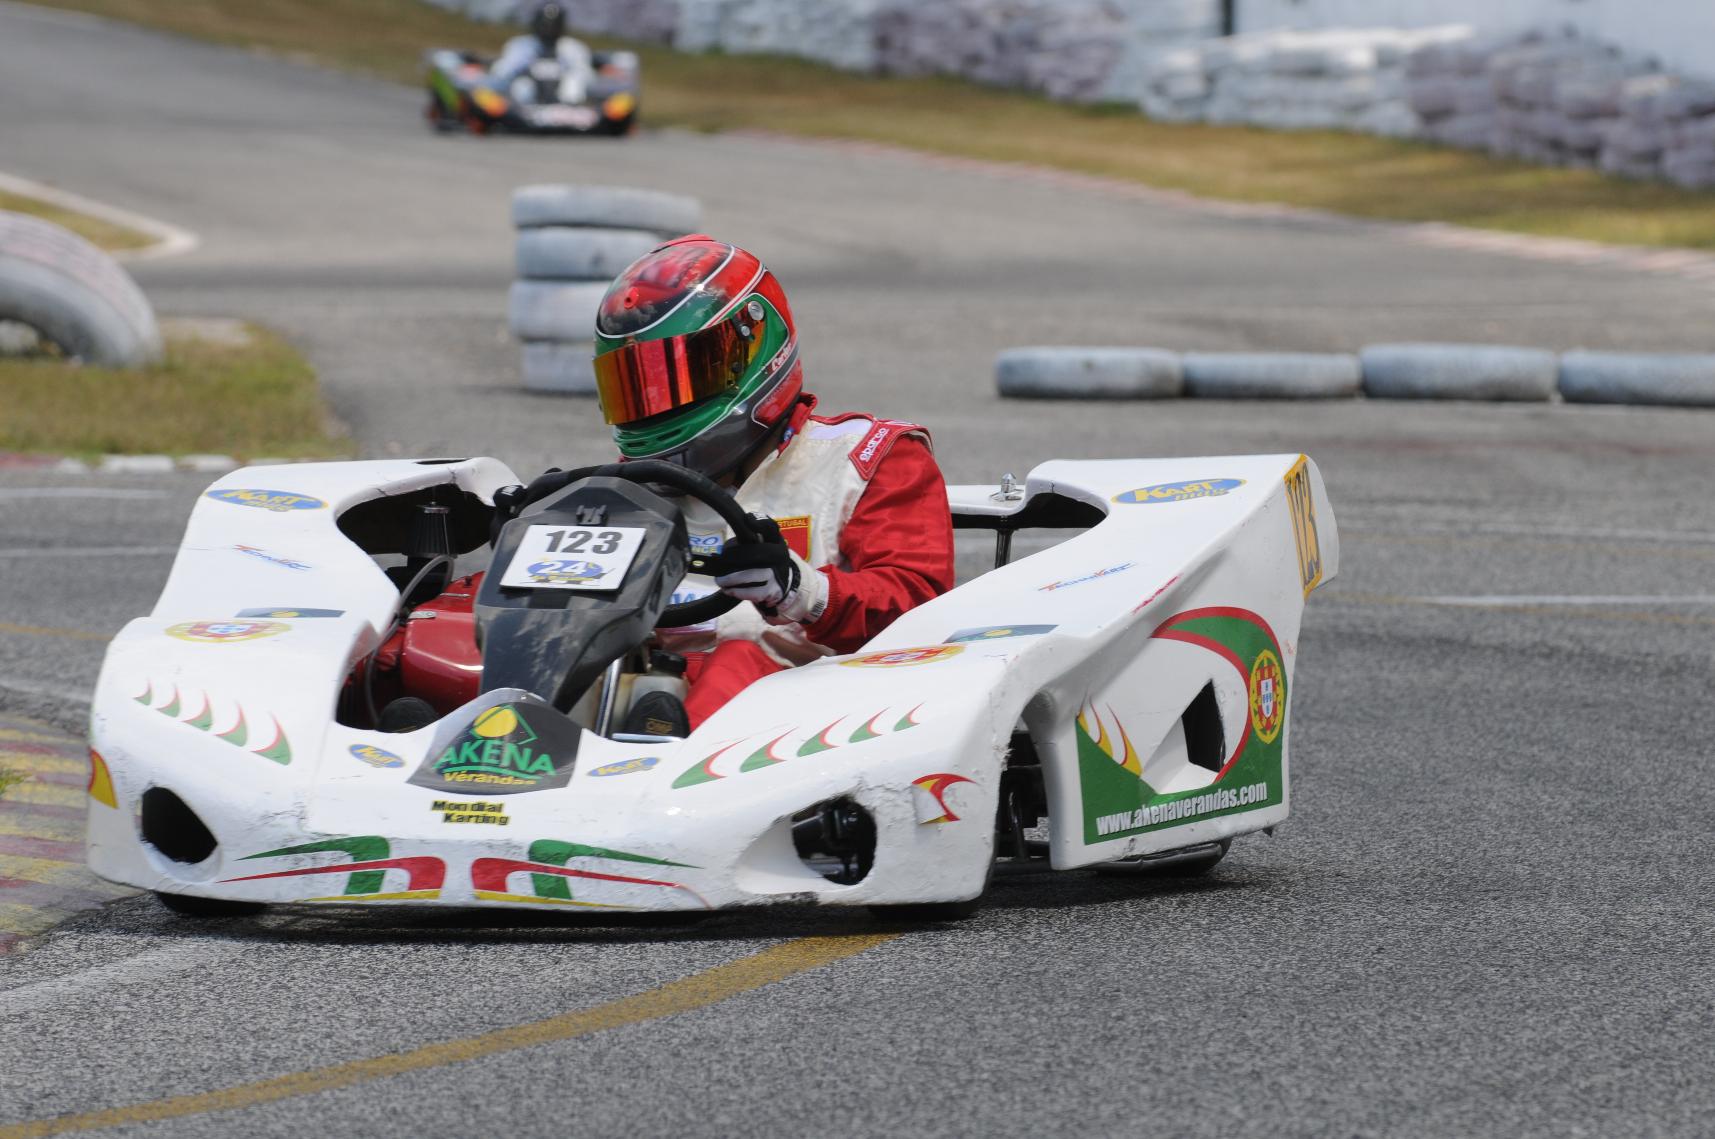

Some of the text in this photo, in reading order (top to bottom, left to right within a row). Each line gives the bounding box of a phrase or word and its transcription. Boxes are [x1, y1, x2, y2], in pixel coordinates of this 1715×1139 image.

[859, 427, 890, 462] sparco
[545, 530, 623, 555] 123
[431, 738, 558, 776] AKENA
[442, 812, 510, 826] Karting
[1096, 782, 1269, 836] www.akenaverandas.com
